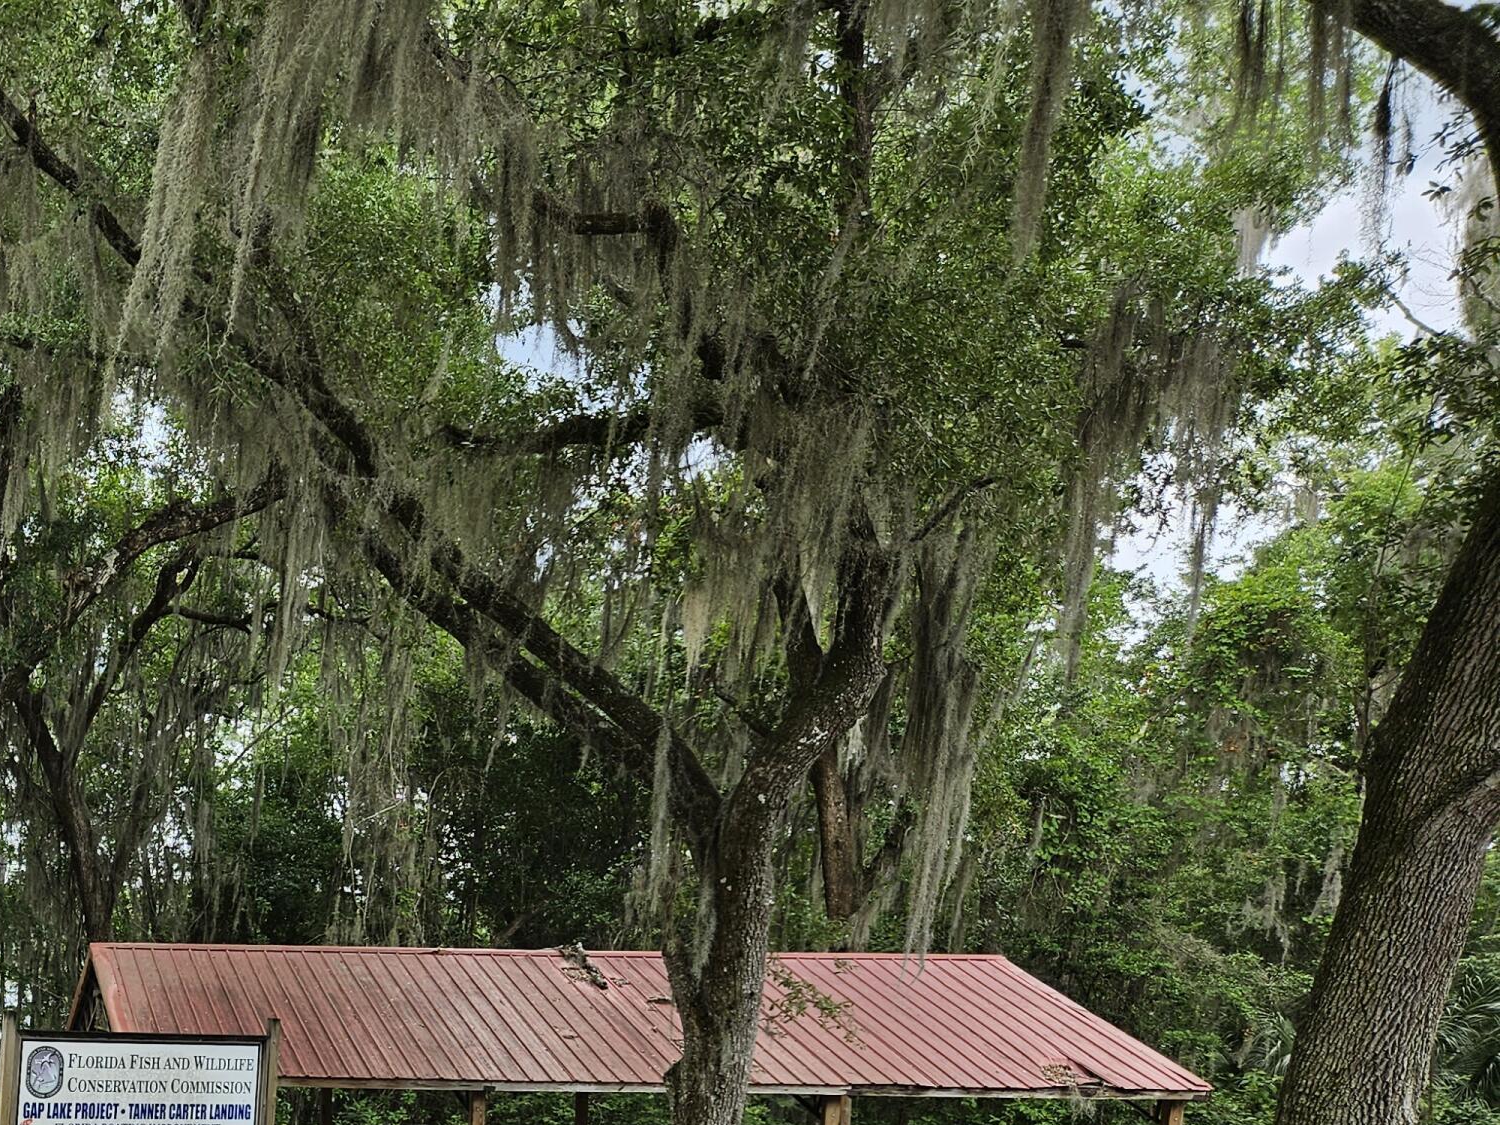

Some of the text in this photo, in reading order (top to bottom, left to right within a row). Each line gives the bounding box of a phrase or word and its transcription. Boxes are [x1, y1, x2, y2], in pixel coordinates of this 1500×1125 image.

[68, 1053, 254, 1071] FLORIDA FISH AND WILDLIFE
[68, 1077, 252, 1094] CONSERVATION COMMISSION
[23, 1102, 251, 1120] GAP LAKE PROJECT TANNER CARTER LANDING
